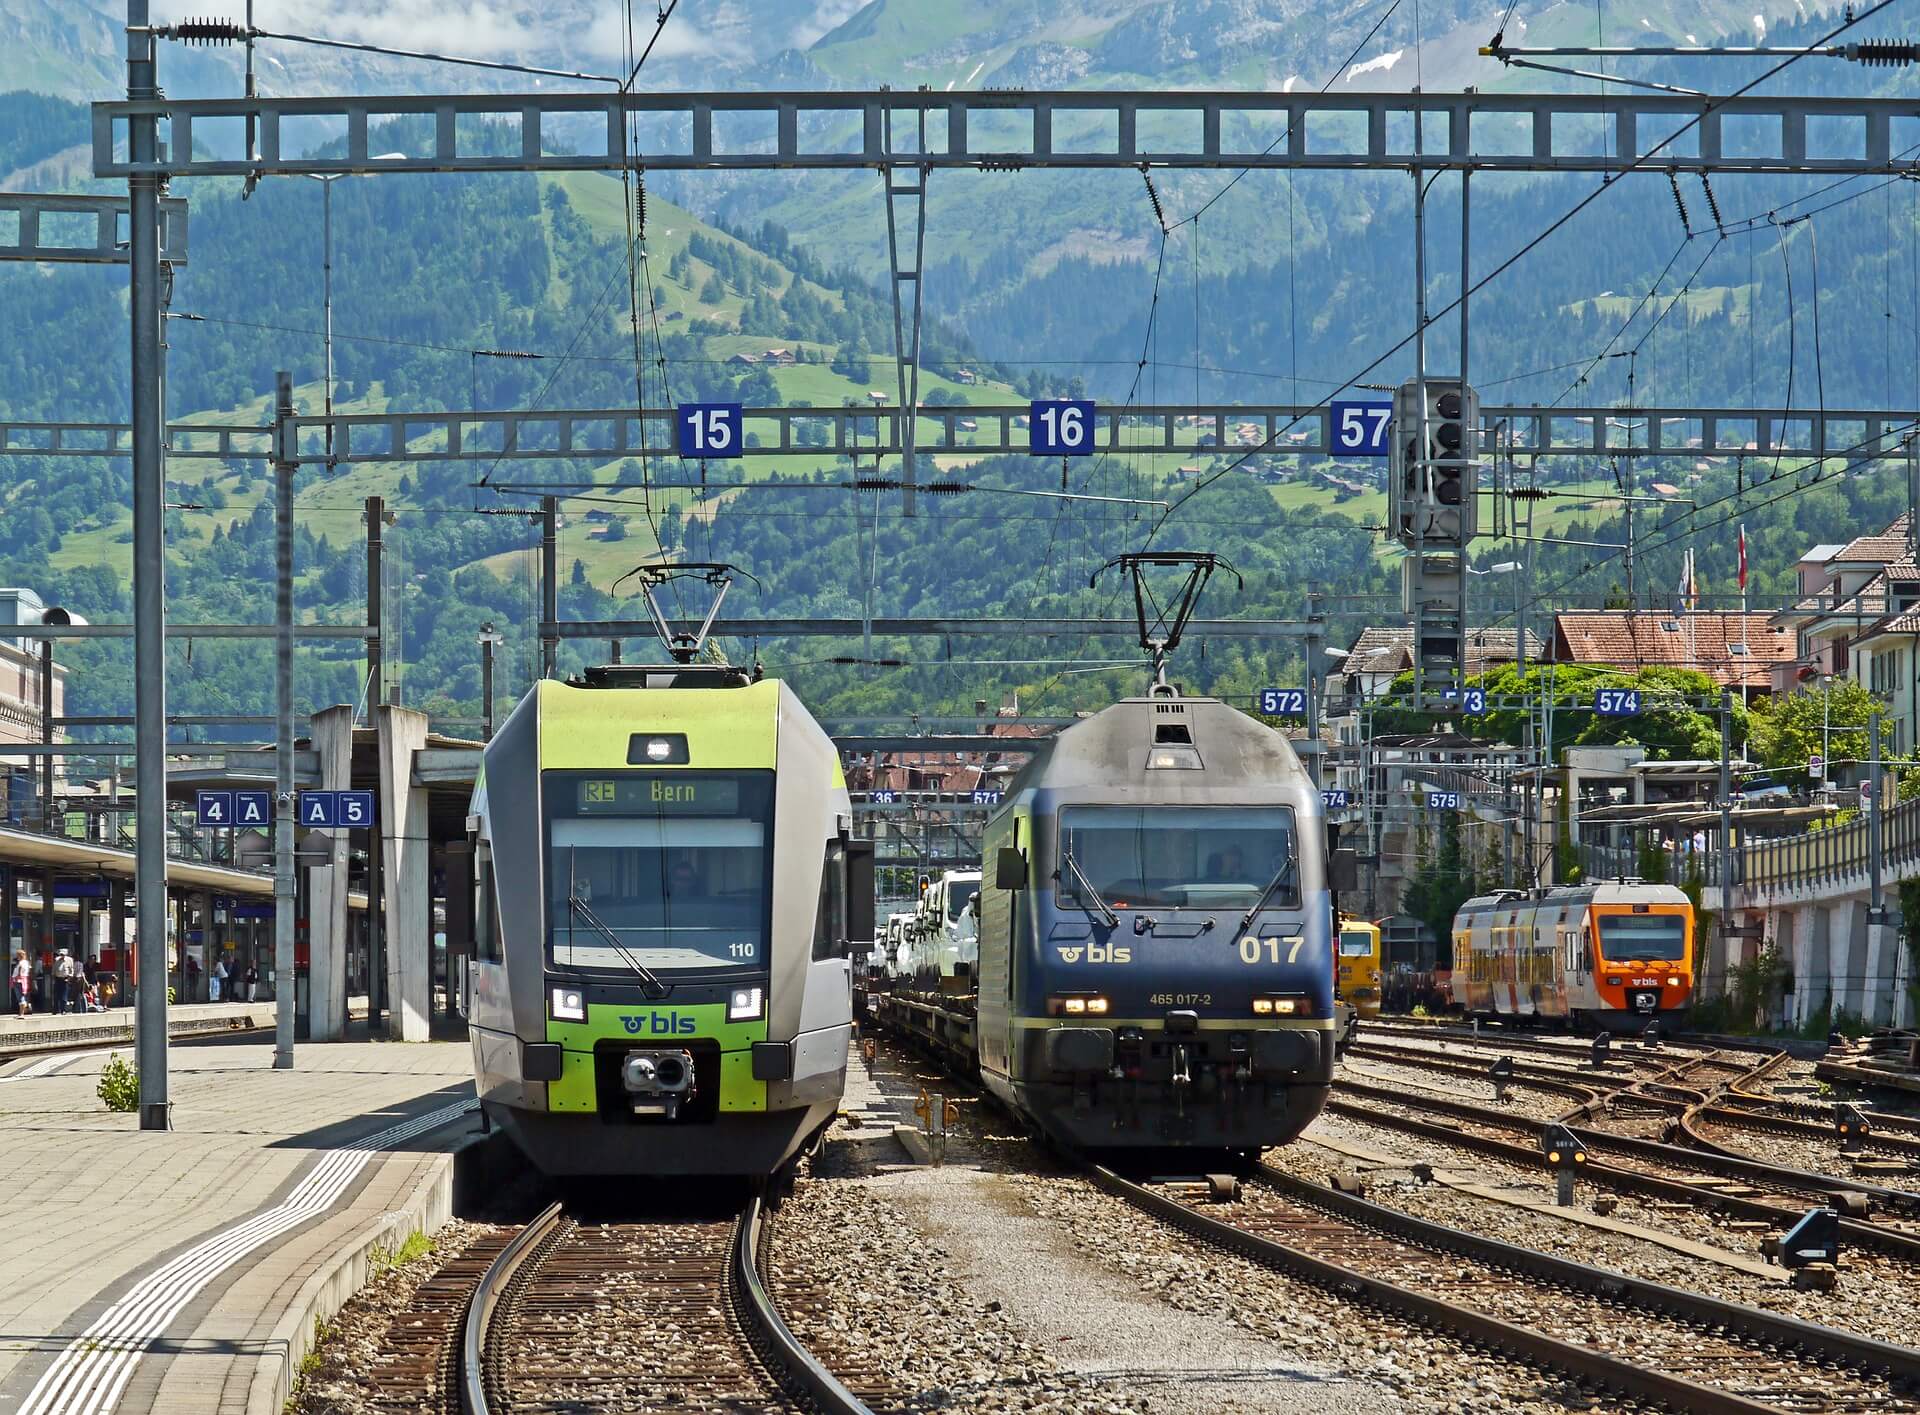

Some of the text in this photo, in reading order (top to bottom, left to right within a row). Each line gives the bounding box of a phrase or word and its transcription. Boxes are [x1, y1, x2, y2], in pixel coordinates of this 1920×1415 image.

[687, 410, 731, 449] 15
[1040, 407, 1083, 447] 16
[1341, 408, 1392, 447] 57
[1264, 691, 1303, 712] 572
[1599, 692, 1637, 711] 574
[585, 780, 695, 801] RE Bern
[1320, 792, 1345, 806] 574
[1430, 793, 1456, 808] 575
[207, 802, 261, 820] 4 A
[309, 802, 362, 821] A 5
[728, 943, 754, 957] 110
[1087, 942, 1131, 963] bls
[1239, 936, 1305, 964] 017
[1642, 977, 1658, 986] bls
[1150, 994, 1211, 1005] 465 017-2
[651, 1011, 696, 1034] bls
